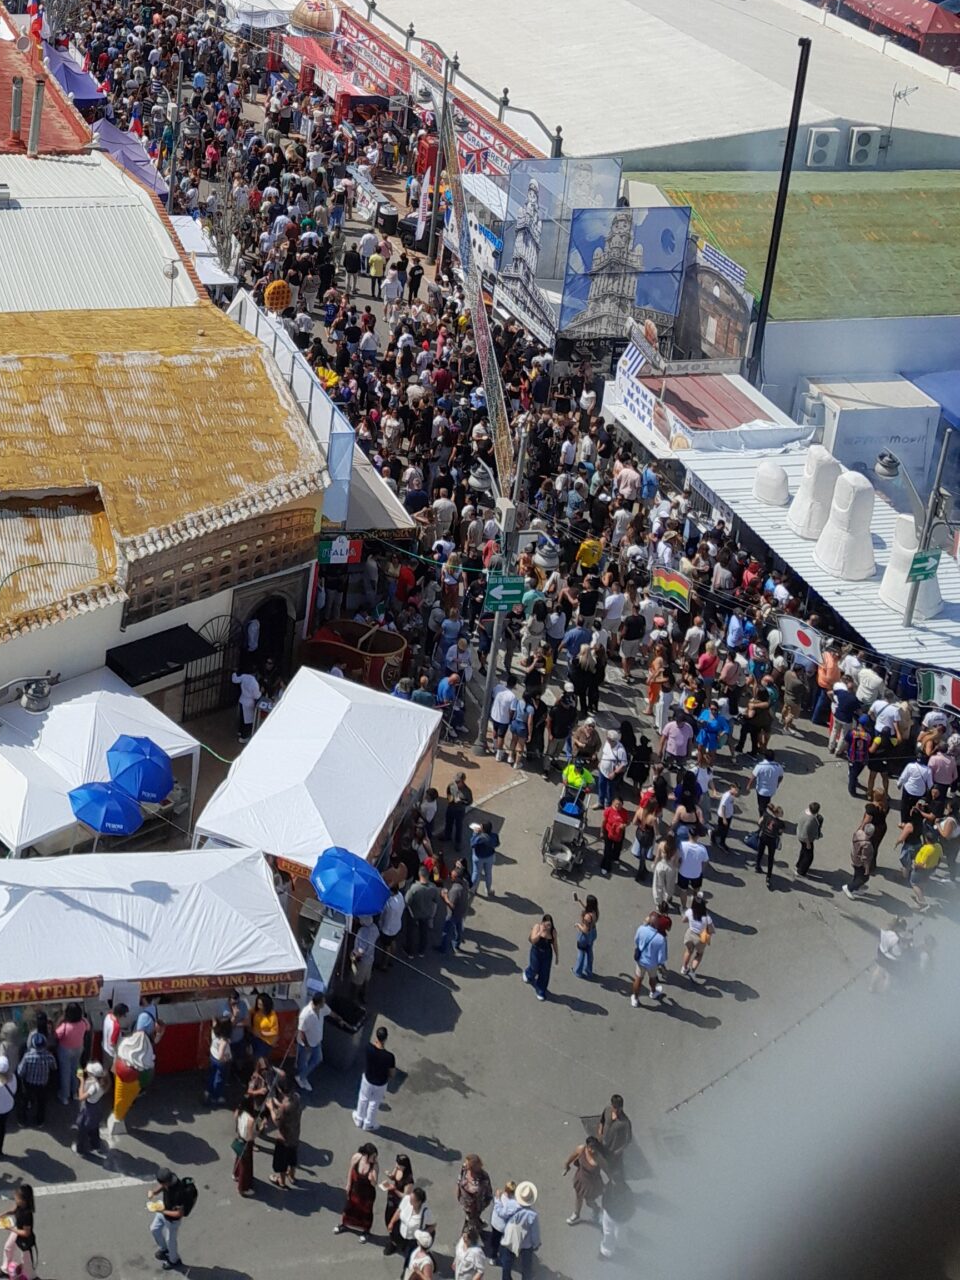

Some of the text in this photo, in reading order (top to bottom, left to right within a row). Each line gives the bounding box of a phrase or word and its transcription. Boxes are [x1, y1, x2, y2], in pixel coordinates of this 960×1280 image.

[487, 149, 511, 173] BRETA
[627, 388, 653, 417] MATE
[630, 381, 653, 406] TOMA
[322, 547, 357, 558] ITALIA
[140, 981, 163, 992] BAR
[171, 976, 209, 988] DRINK
[217, 975, 247, 987] VINO
